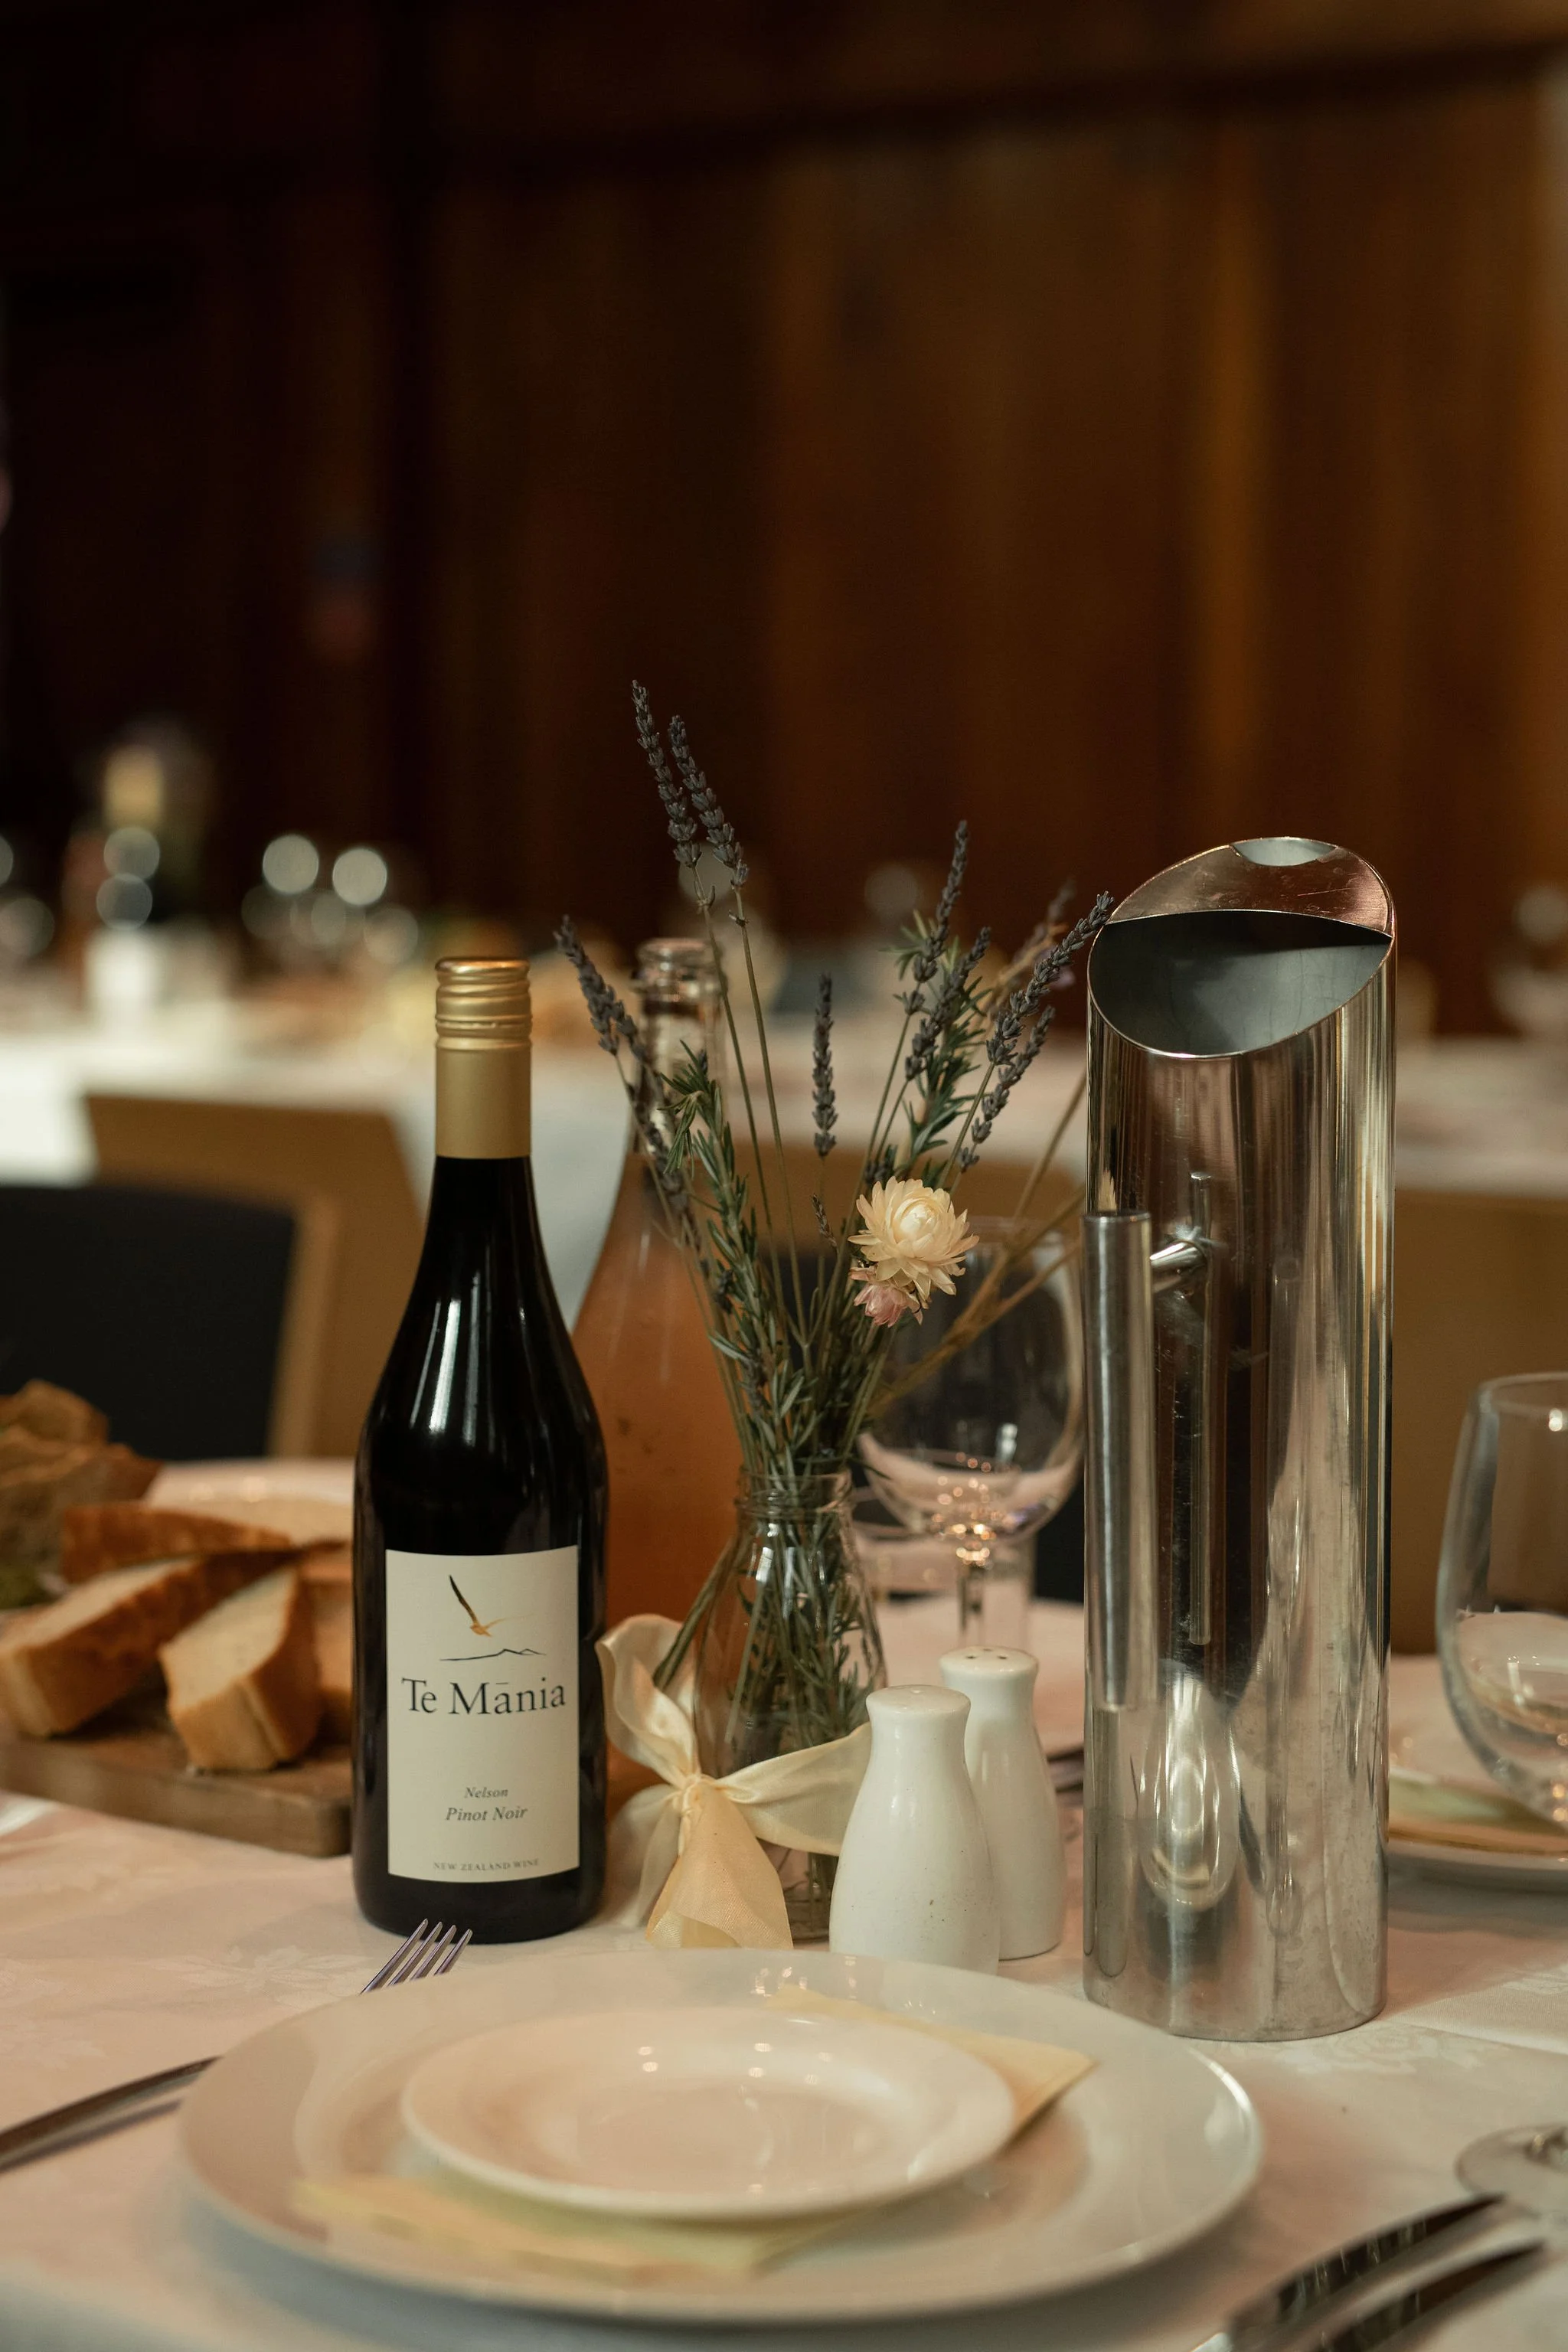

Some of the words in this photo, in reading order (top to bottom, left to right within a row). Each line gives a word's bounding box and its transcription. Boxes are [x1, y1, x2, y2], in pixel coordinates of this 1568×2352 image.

[401, 1677, 436, 1713] Te
[448, 1676, 566, 1715] Mānia
[464, 1786, 509, 1798] Nelson
[446, 1807, 488, 1821] Pinot
[492, 1805, 528, 1821] Noir
[433, 1861, 457, 1870] NEW
[460, 1861, 511, 1871] ZEALAND
[512, 1857, 539, 1868] WINE
